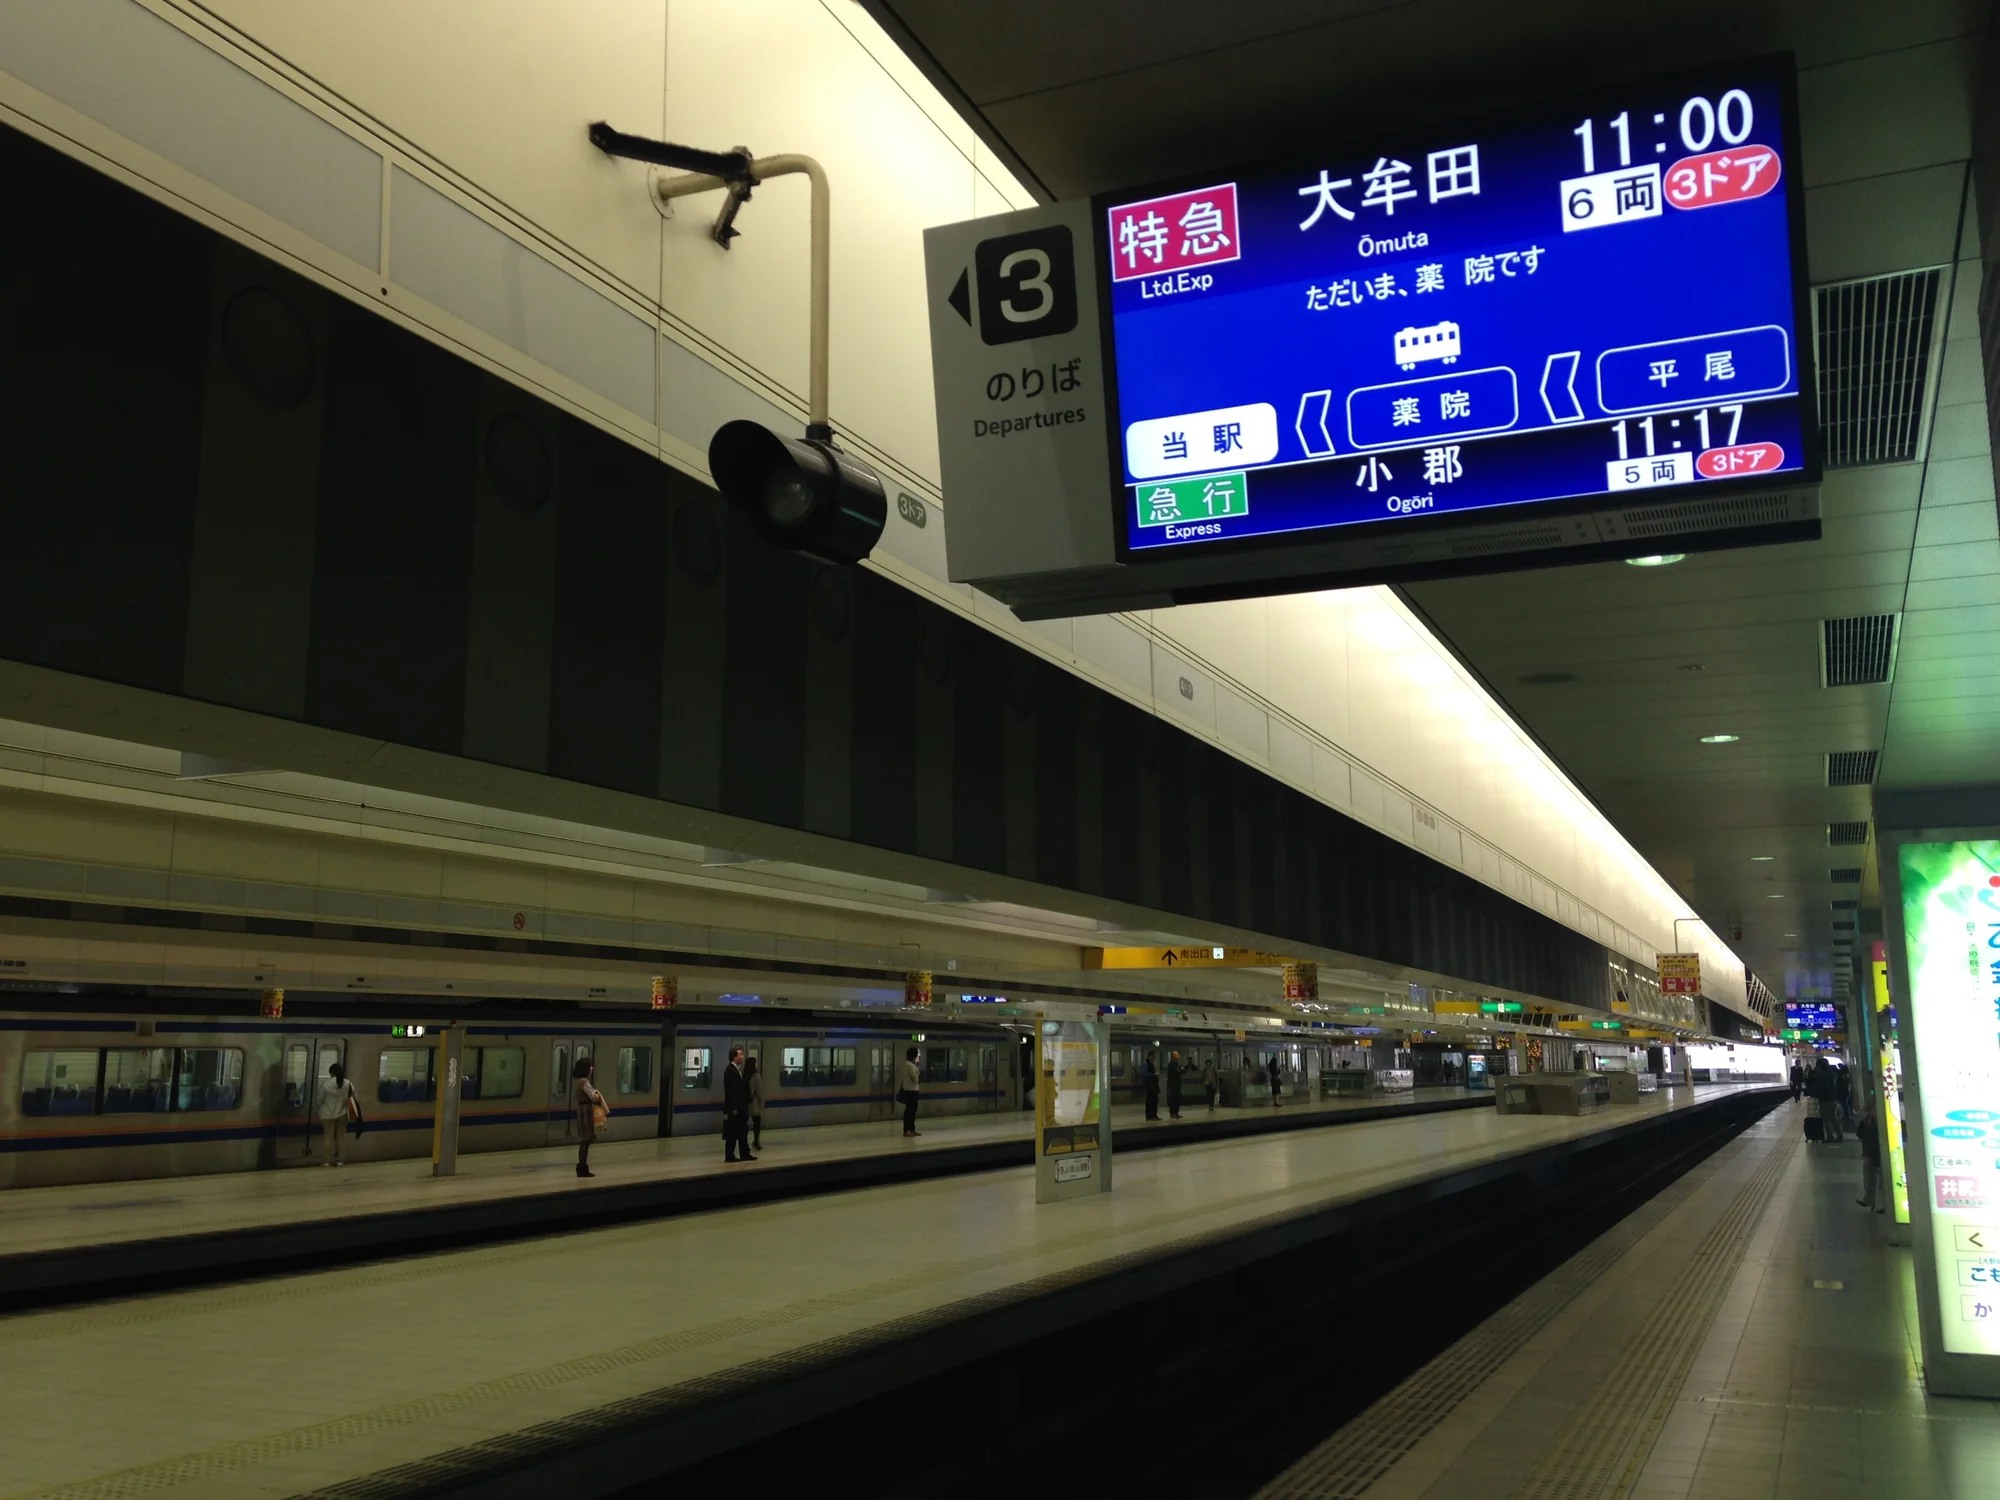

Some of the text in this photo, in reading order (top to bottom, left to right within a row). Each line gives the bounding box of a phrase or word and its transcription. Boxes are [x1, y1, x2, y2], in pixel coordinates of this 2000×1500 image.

[1574, 89, 1753, 173] 11:00
[1298, 144, 1482, 232] 大牟田
[1568, 173, 1656, 220] 6両
[1670, 151, 1773, 203] 3ドア
[1118, 201, 1231, 269] 特急
[1357, 230, 1429, 257] Ōmuta
[999, 248, 1054, 323] 3
[1140, 273, 1214, 299] Ltd.Exp
[986, 357, 1082, 402] のりば
[1648, 351, 1735, 388] 平尾
[973, 407, 1086, 437] Departures
[1392, 390, 1471, 427] 薬院
[1162, 422, 1243, 460] 当駅
[1611, 404, 1744, 460] 11:17
[1355, 445, 1464, 493] 小郡
[1623, 458, 1676, 484] 5両
[1711, 449, 1767, 473] 3ドア
[1148, 480, 1236, 522] 急行
[1386, 492, 1434, 513] Ogōri
[1165, 521, 1222, 540] Express
